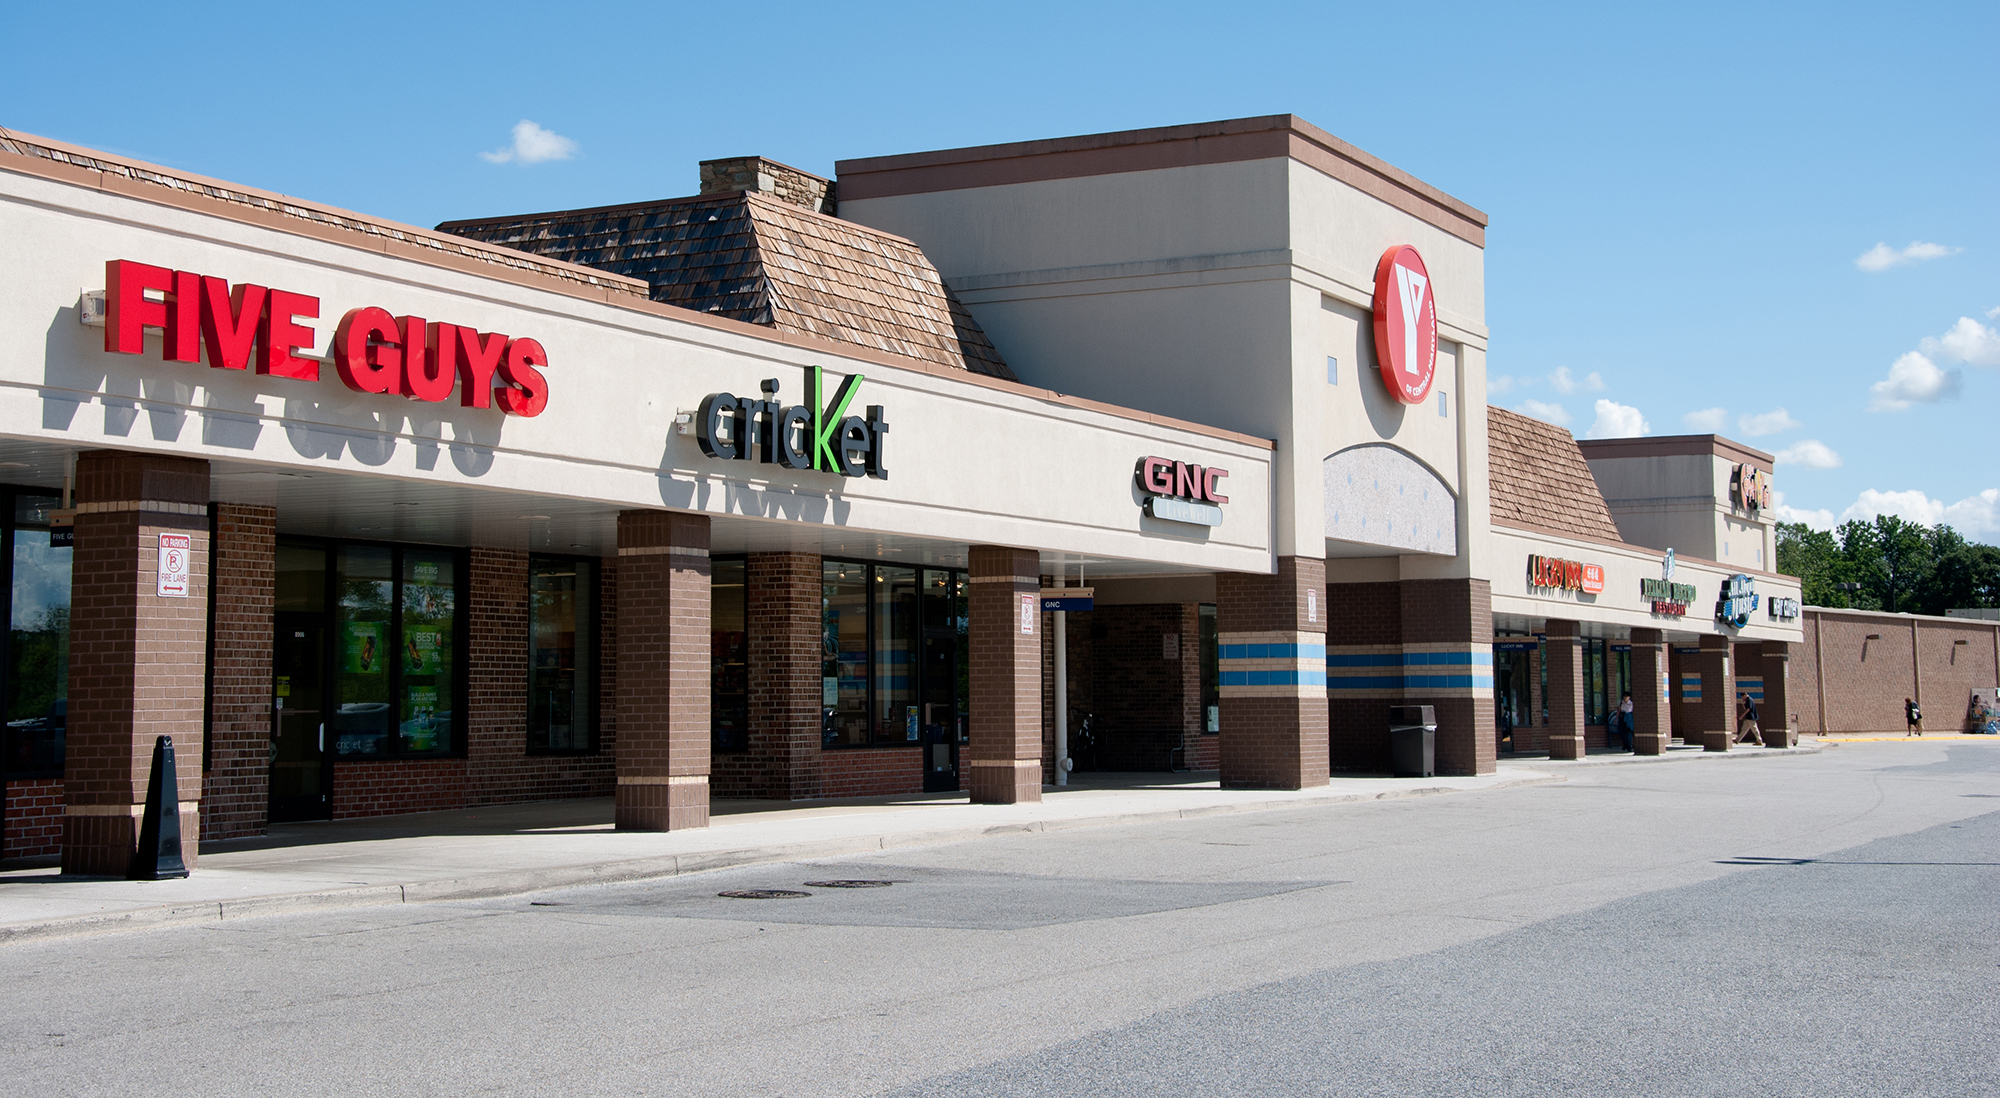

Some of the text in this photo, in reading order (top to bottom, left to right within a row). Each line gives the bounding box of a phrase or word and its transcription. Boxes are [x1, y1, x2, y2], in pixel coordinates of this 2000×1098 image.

[105, 259, 549, 418] FIVE GUYS
[1412, 371, 1431, 397] CENTRAL
[1135, 455, 1229, 504] GNC
[52, 532, 66, 540] FIVE
[162, 537, 188, 549] NO PARKING
[414, 566, 438, 575] SAVE BIG
[1529, 554, 1581, 592] LUCKY INN
[162, 573, 186, 583] FIRE LANE
[416, 632, 436, 643] BEST
[335, 740, 361, 750] cricet
